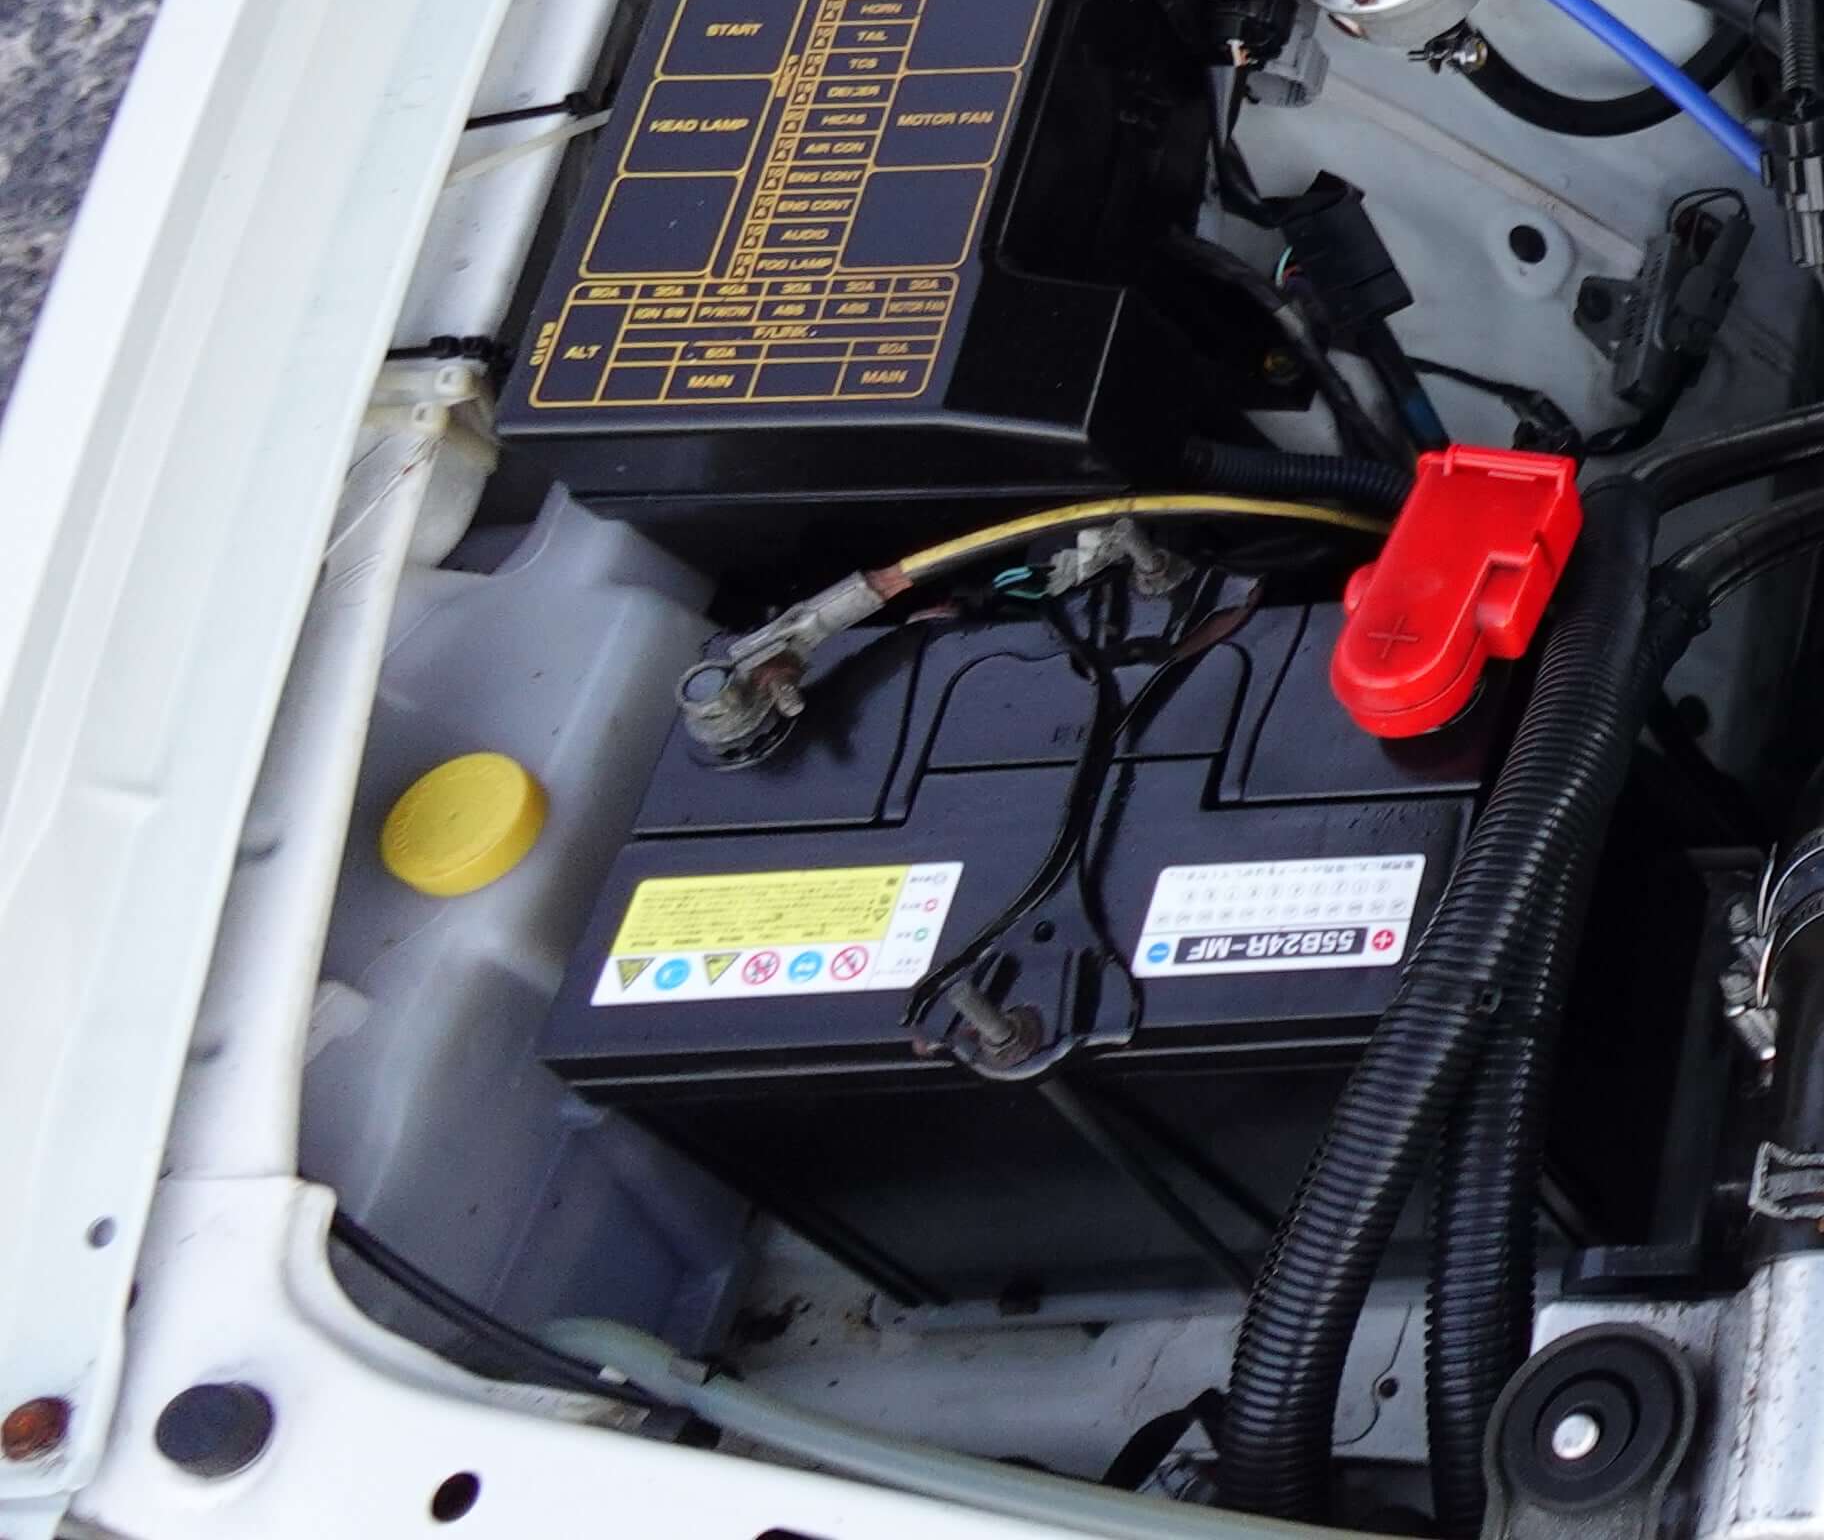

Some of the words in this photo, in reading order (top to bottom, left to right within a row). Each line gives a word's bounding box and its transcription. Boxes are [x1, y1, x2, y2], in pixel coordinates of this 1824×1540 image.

[705, 23, 763, 37] START
[856, 31, 888, 41] TAIL
[649, 119, 698, 133] HEAD
[699, 117, 750, 132] LAMP
[896, 113, 956, 126] MOTOR
[957, 110, 994, 124] FAN
[562, 345, 603, 360] ALT
[686, 374, 735, 390] MAIN
[861, 369, 909, 385] MAIN
[1186, 929, 1356, 961] 55B24R-MF
